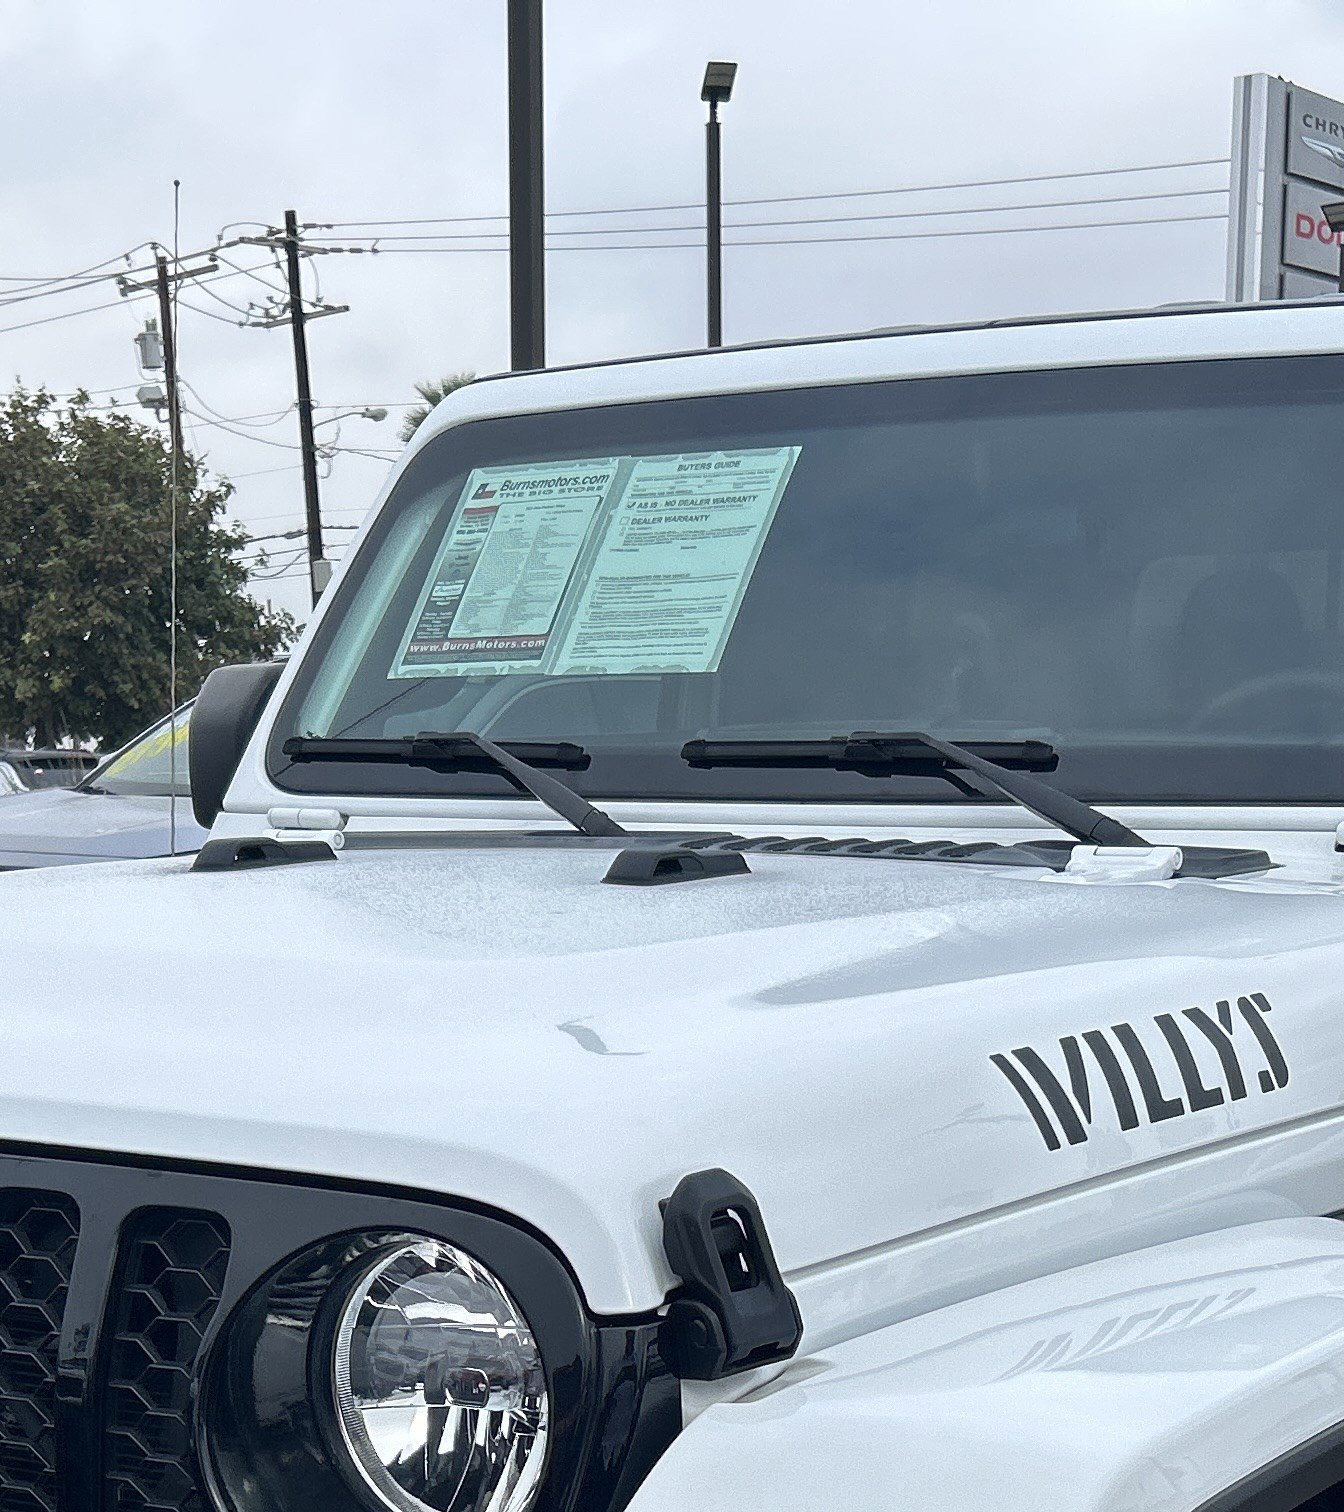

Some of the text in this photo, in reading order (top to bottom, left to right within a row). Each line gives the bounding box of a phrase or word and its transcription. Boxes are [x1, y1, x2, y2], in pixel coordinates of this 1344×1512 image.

[677, 460, 742, 472] BUYERS GUIDE
[500, 473, 610, 493] Burnsmotors.com
[499, 484, 605, 498] THE BIG STORE
[664, 500, 677, 508] NO
[677, 498, 710, 507] DEALER
[711, 495, 759, 505] WARRANTY
[631, 514, 711, 526] DEALER WARRANTY
[409, 638, 545, 653] www.BurnsMotors.com
[989, 992, 1288, 1151] WILLYS
